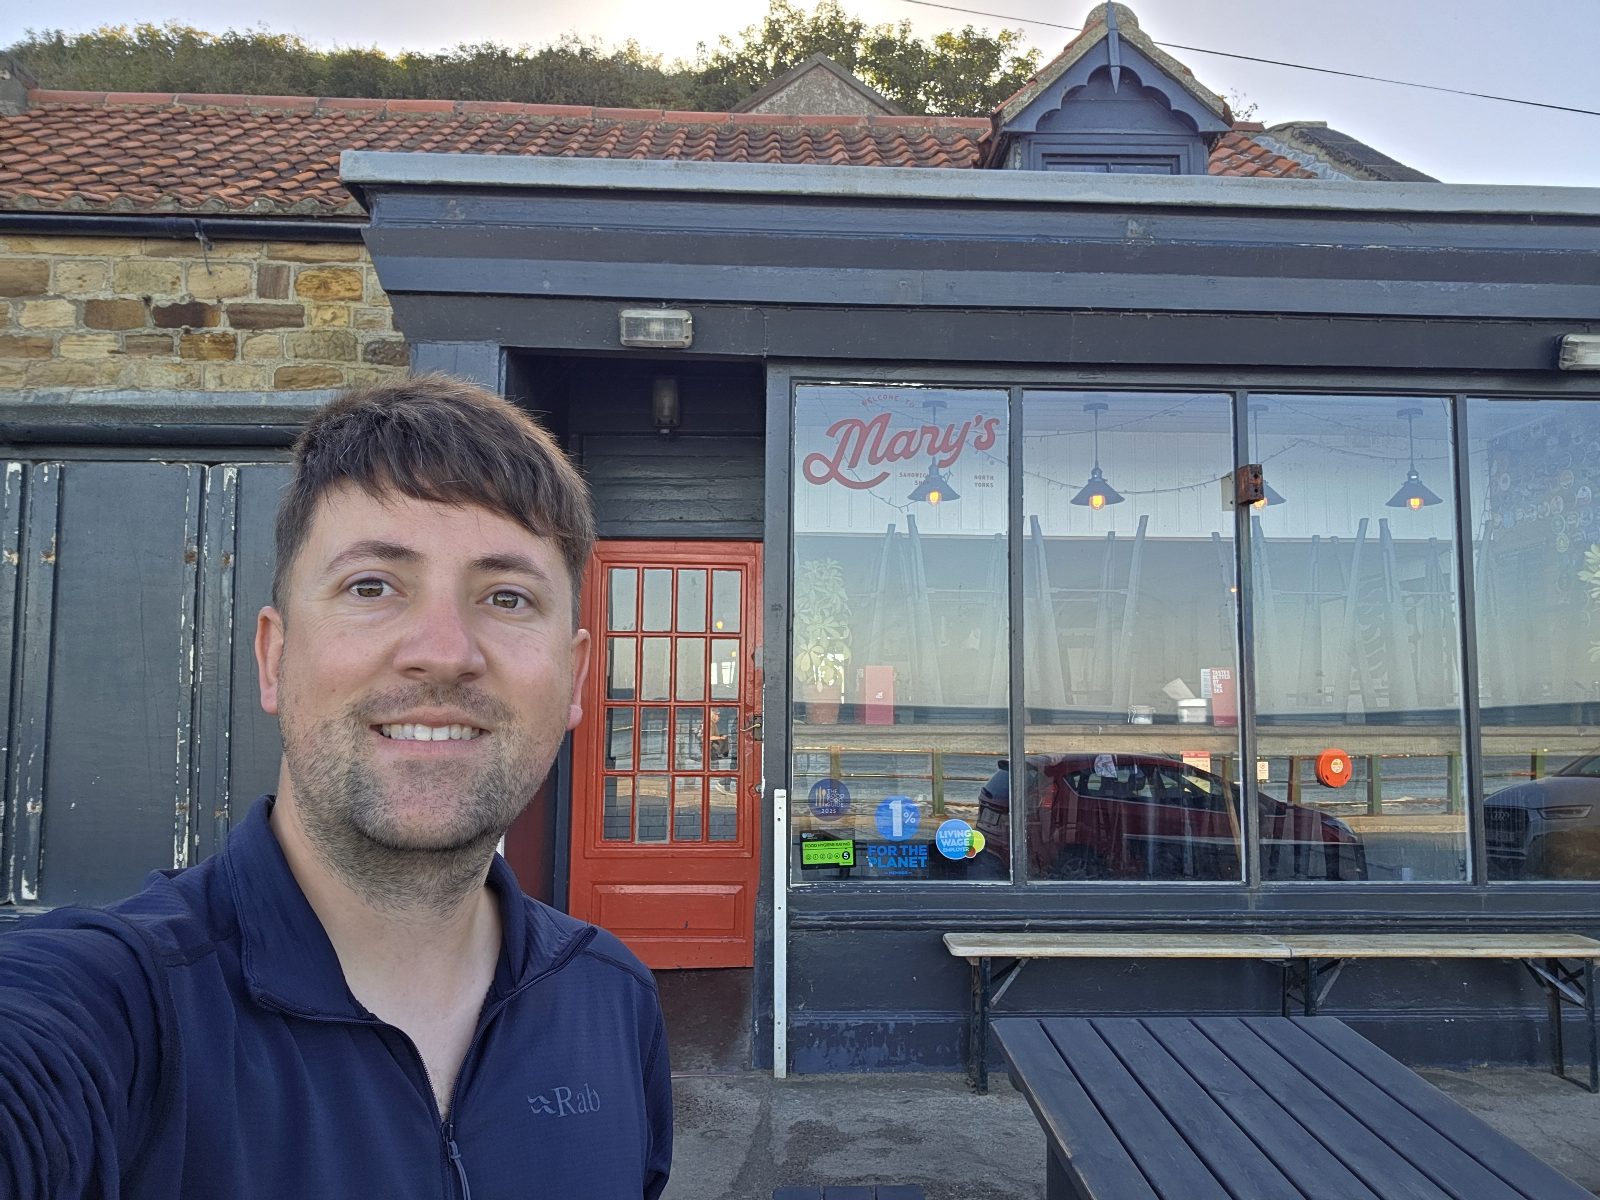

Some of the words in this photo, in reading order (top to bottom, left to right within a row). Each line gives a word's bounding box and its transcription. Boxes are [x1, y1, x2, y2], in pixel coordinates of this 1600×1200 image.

[803, 412, 1000, 489] Mary's
[939, 830, 972, 839] LIVING
[941, 838, 970, 847] WAGE
[868, 845, 897, 856] FOR
[900, 845, 928, 856] THE
[868, 857, 928, 868] PLANET
[552, 1082, 600, 1117] Rab
